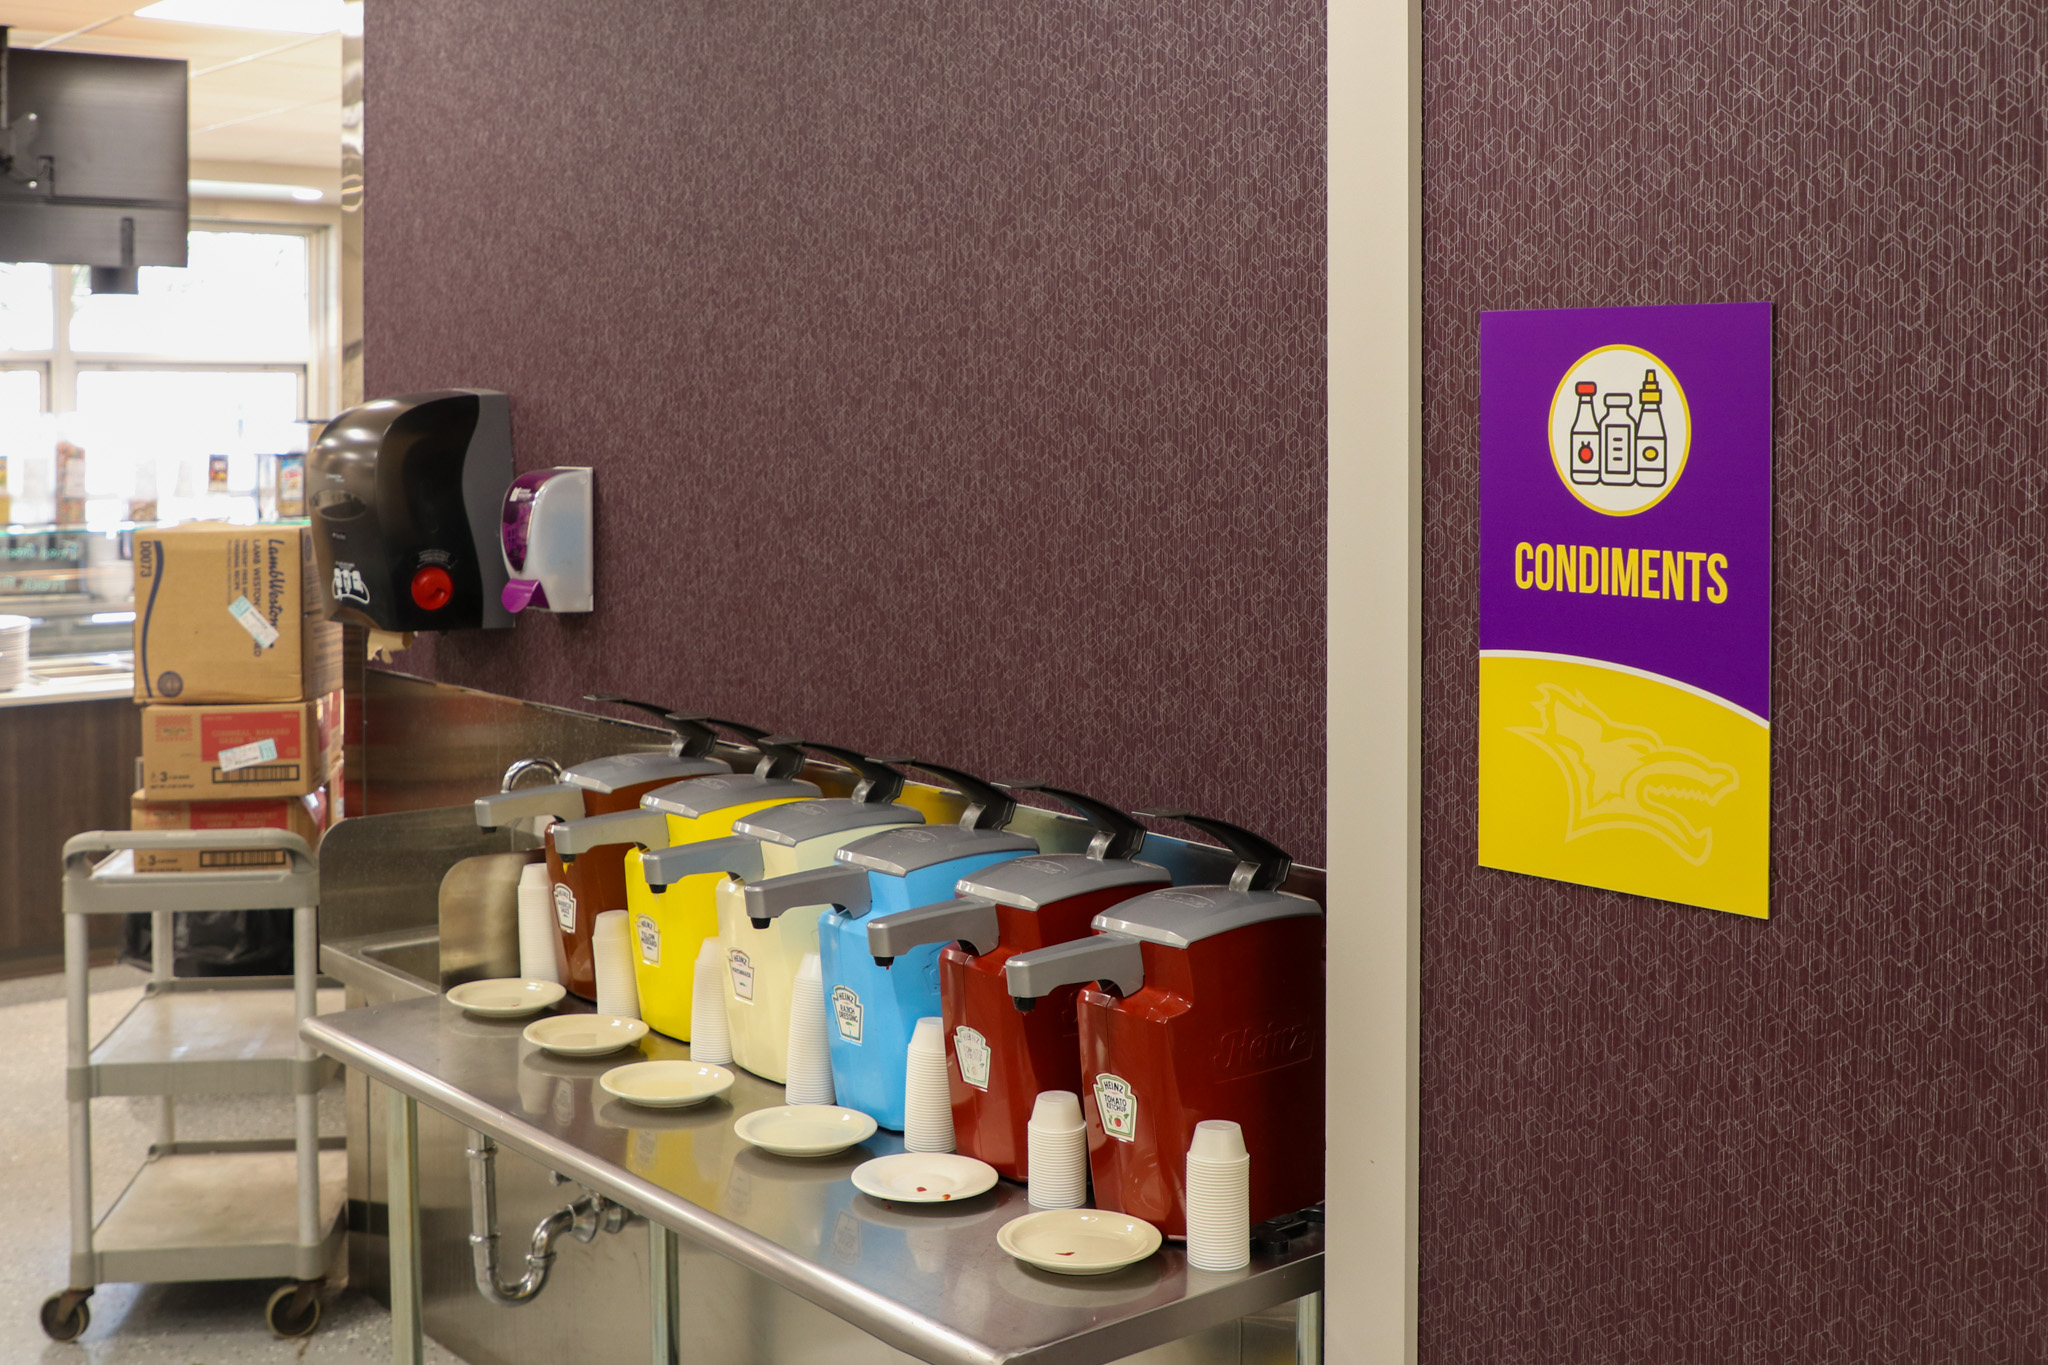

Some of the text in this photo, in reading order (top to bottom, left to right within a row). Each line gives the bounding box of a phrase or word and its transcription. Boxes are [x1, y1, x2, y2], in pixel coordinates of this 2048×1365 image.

[253, 539, 262, 564] LAMB
[1515, 542, 1728, 604] CONDIMENTS
[160, 771, 168, 782] 3
[838, 992, 854, 1004] HEINZ
[839, 1003, 856, 1015] RANCH
[1103, 1080, 1124, 1094] HEINZ
[1103, 1093, 1127, 1107] TOMATO
[1106, 1102, 1127, 1113] KETCHUP
